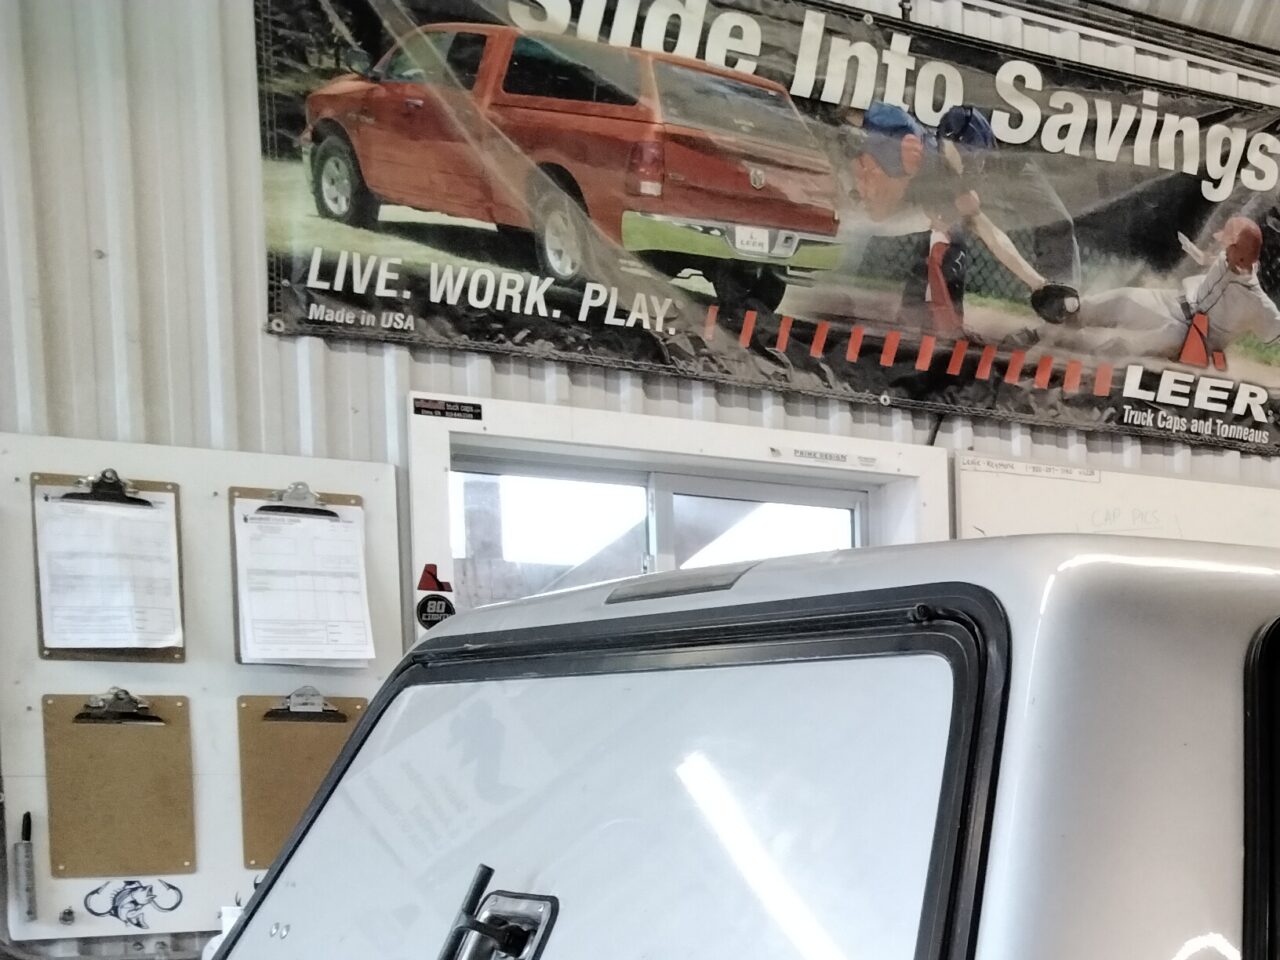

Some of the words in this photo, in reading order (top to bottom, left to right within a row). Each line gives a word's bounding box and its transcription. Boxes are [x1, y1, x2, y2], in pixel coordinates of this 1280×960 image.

[789, 9, 964, 127] Into
[306, 246, 412, 299] LIVE.
[428, 262, 562, 318] WORK.
[577, 282, 676, 336] PLAY.
[308, 303, 355, 324] Made
[360, 310, 376, 327] in
[380, 311, 415, 331] USA
[1122, 364, 1269, 424] LEER
[1122, 404, 1155, 427] Truck
[1157, 410, 1188, 434] Caps
[1190, 417, 1213, 436] and
[1216, 419, 1270, 444] Tonneaus
[426, 600, 446, 614] 80
